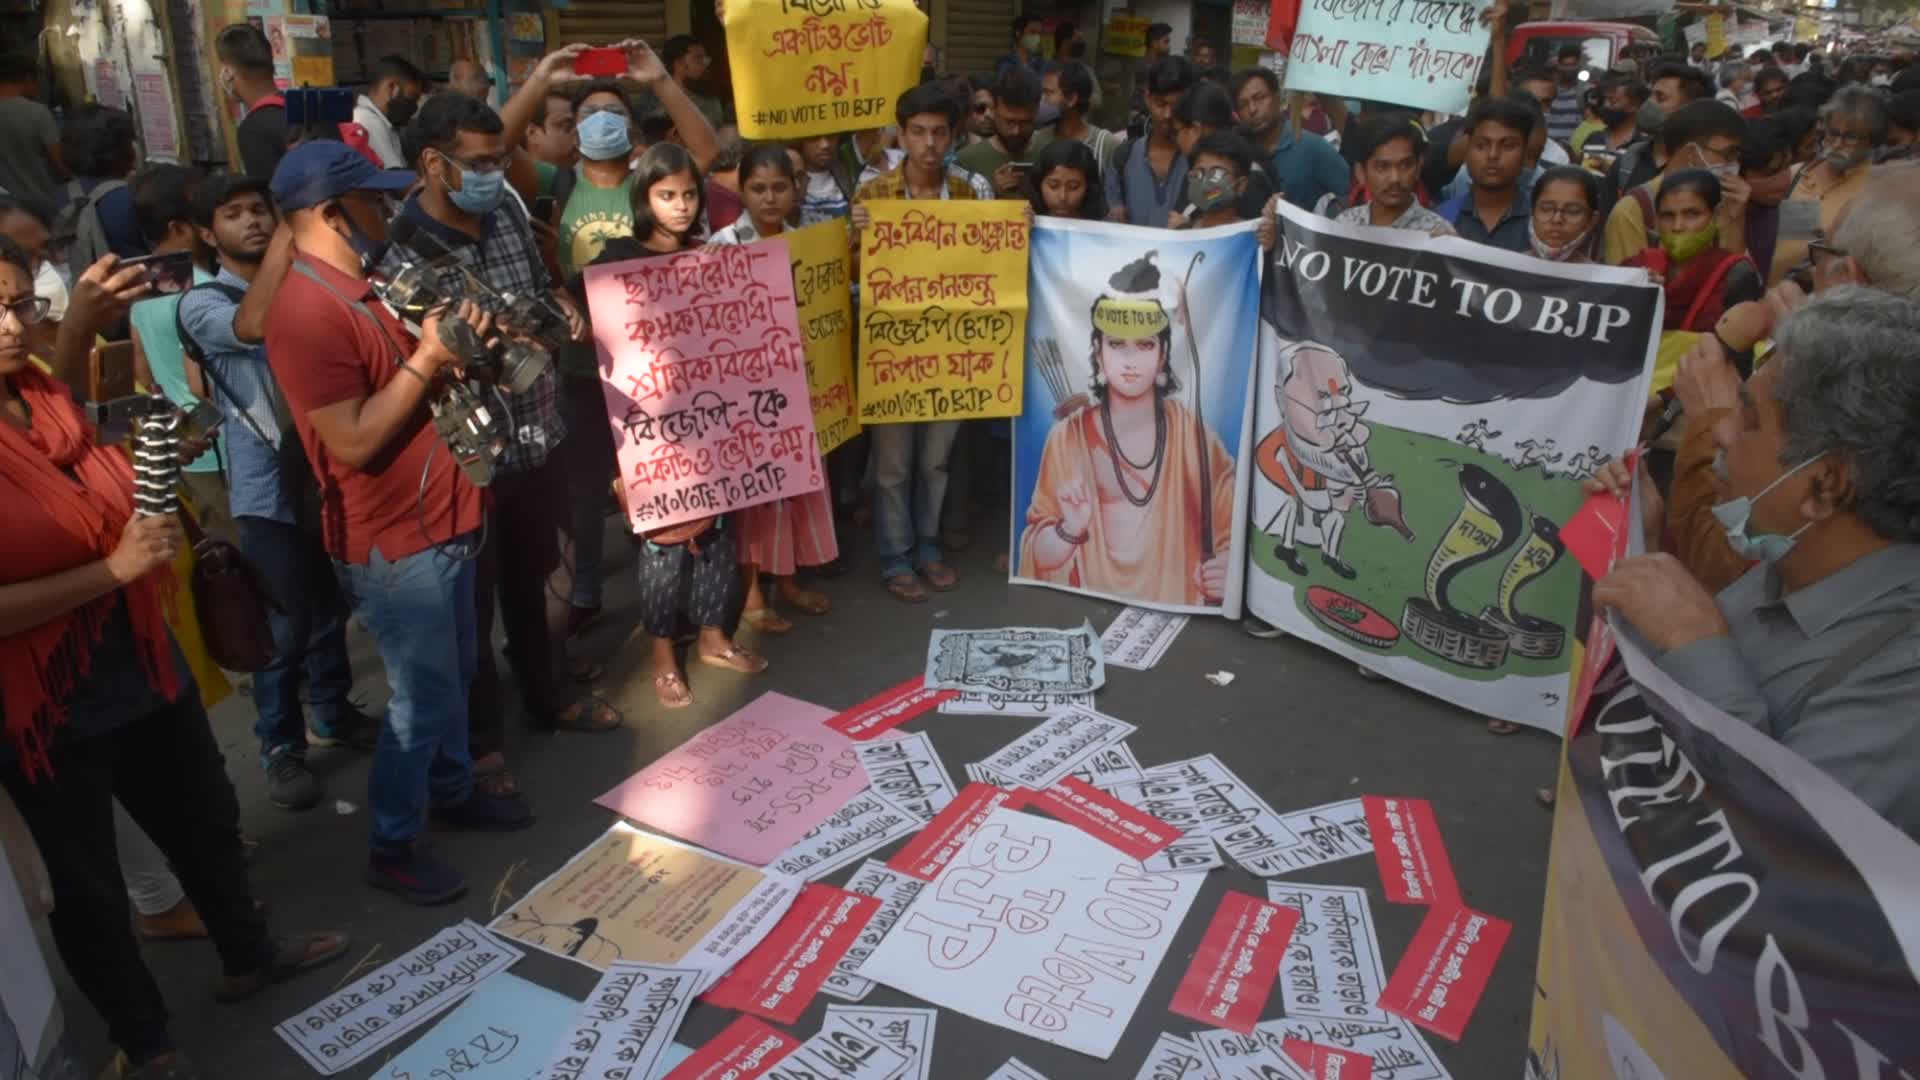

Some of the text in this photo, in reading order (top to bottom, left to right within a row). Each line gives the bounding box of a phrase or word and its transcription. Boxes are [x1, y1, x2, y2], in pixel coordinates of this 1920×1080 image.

[791, 103, 827, 125] VOTE
[832, 101, 849, 119] TO
[854, 97, 886, 117] BJP
[1105, 309, 1129, 325] VOTE
[1132, 310, 1145, 324] TO
[1275, 236, 1632, 343] NO VOTE TO BJP
[904, 823, 1050, 971] BJP
[1086, 863, 1180, 940] NO
[1640, 808, 1759, 976] TO
